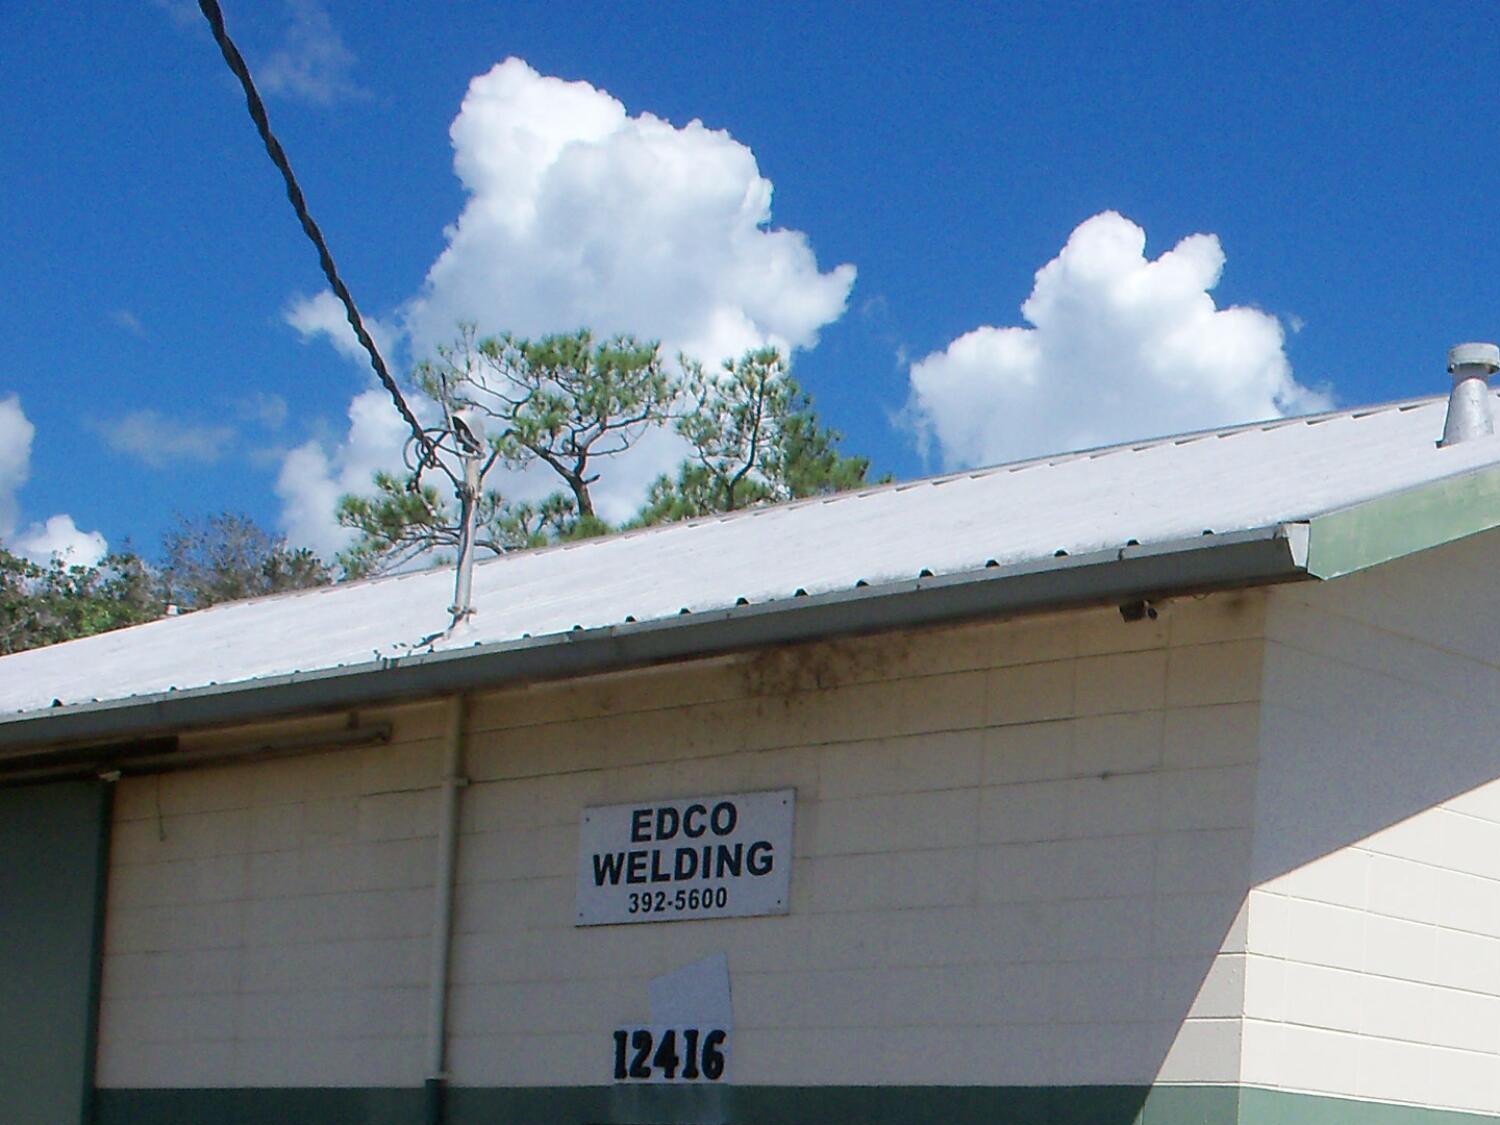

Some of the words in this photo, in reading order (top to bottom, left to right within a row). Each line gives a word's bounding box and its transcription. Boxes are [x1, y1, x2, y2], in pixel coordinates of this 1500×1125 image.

[631, 802, 737, 842] EDCO
[593, 841, 773, 886] WELDING
[628, 887, 727, 913] 392-5600
[613, 1029, 727, 1080] 12416
